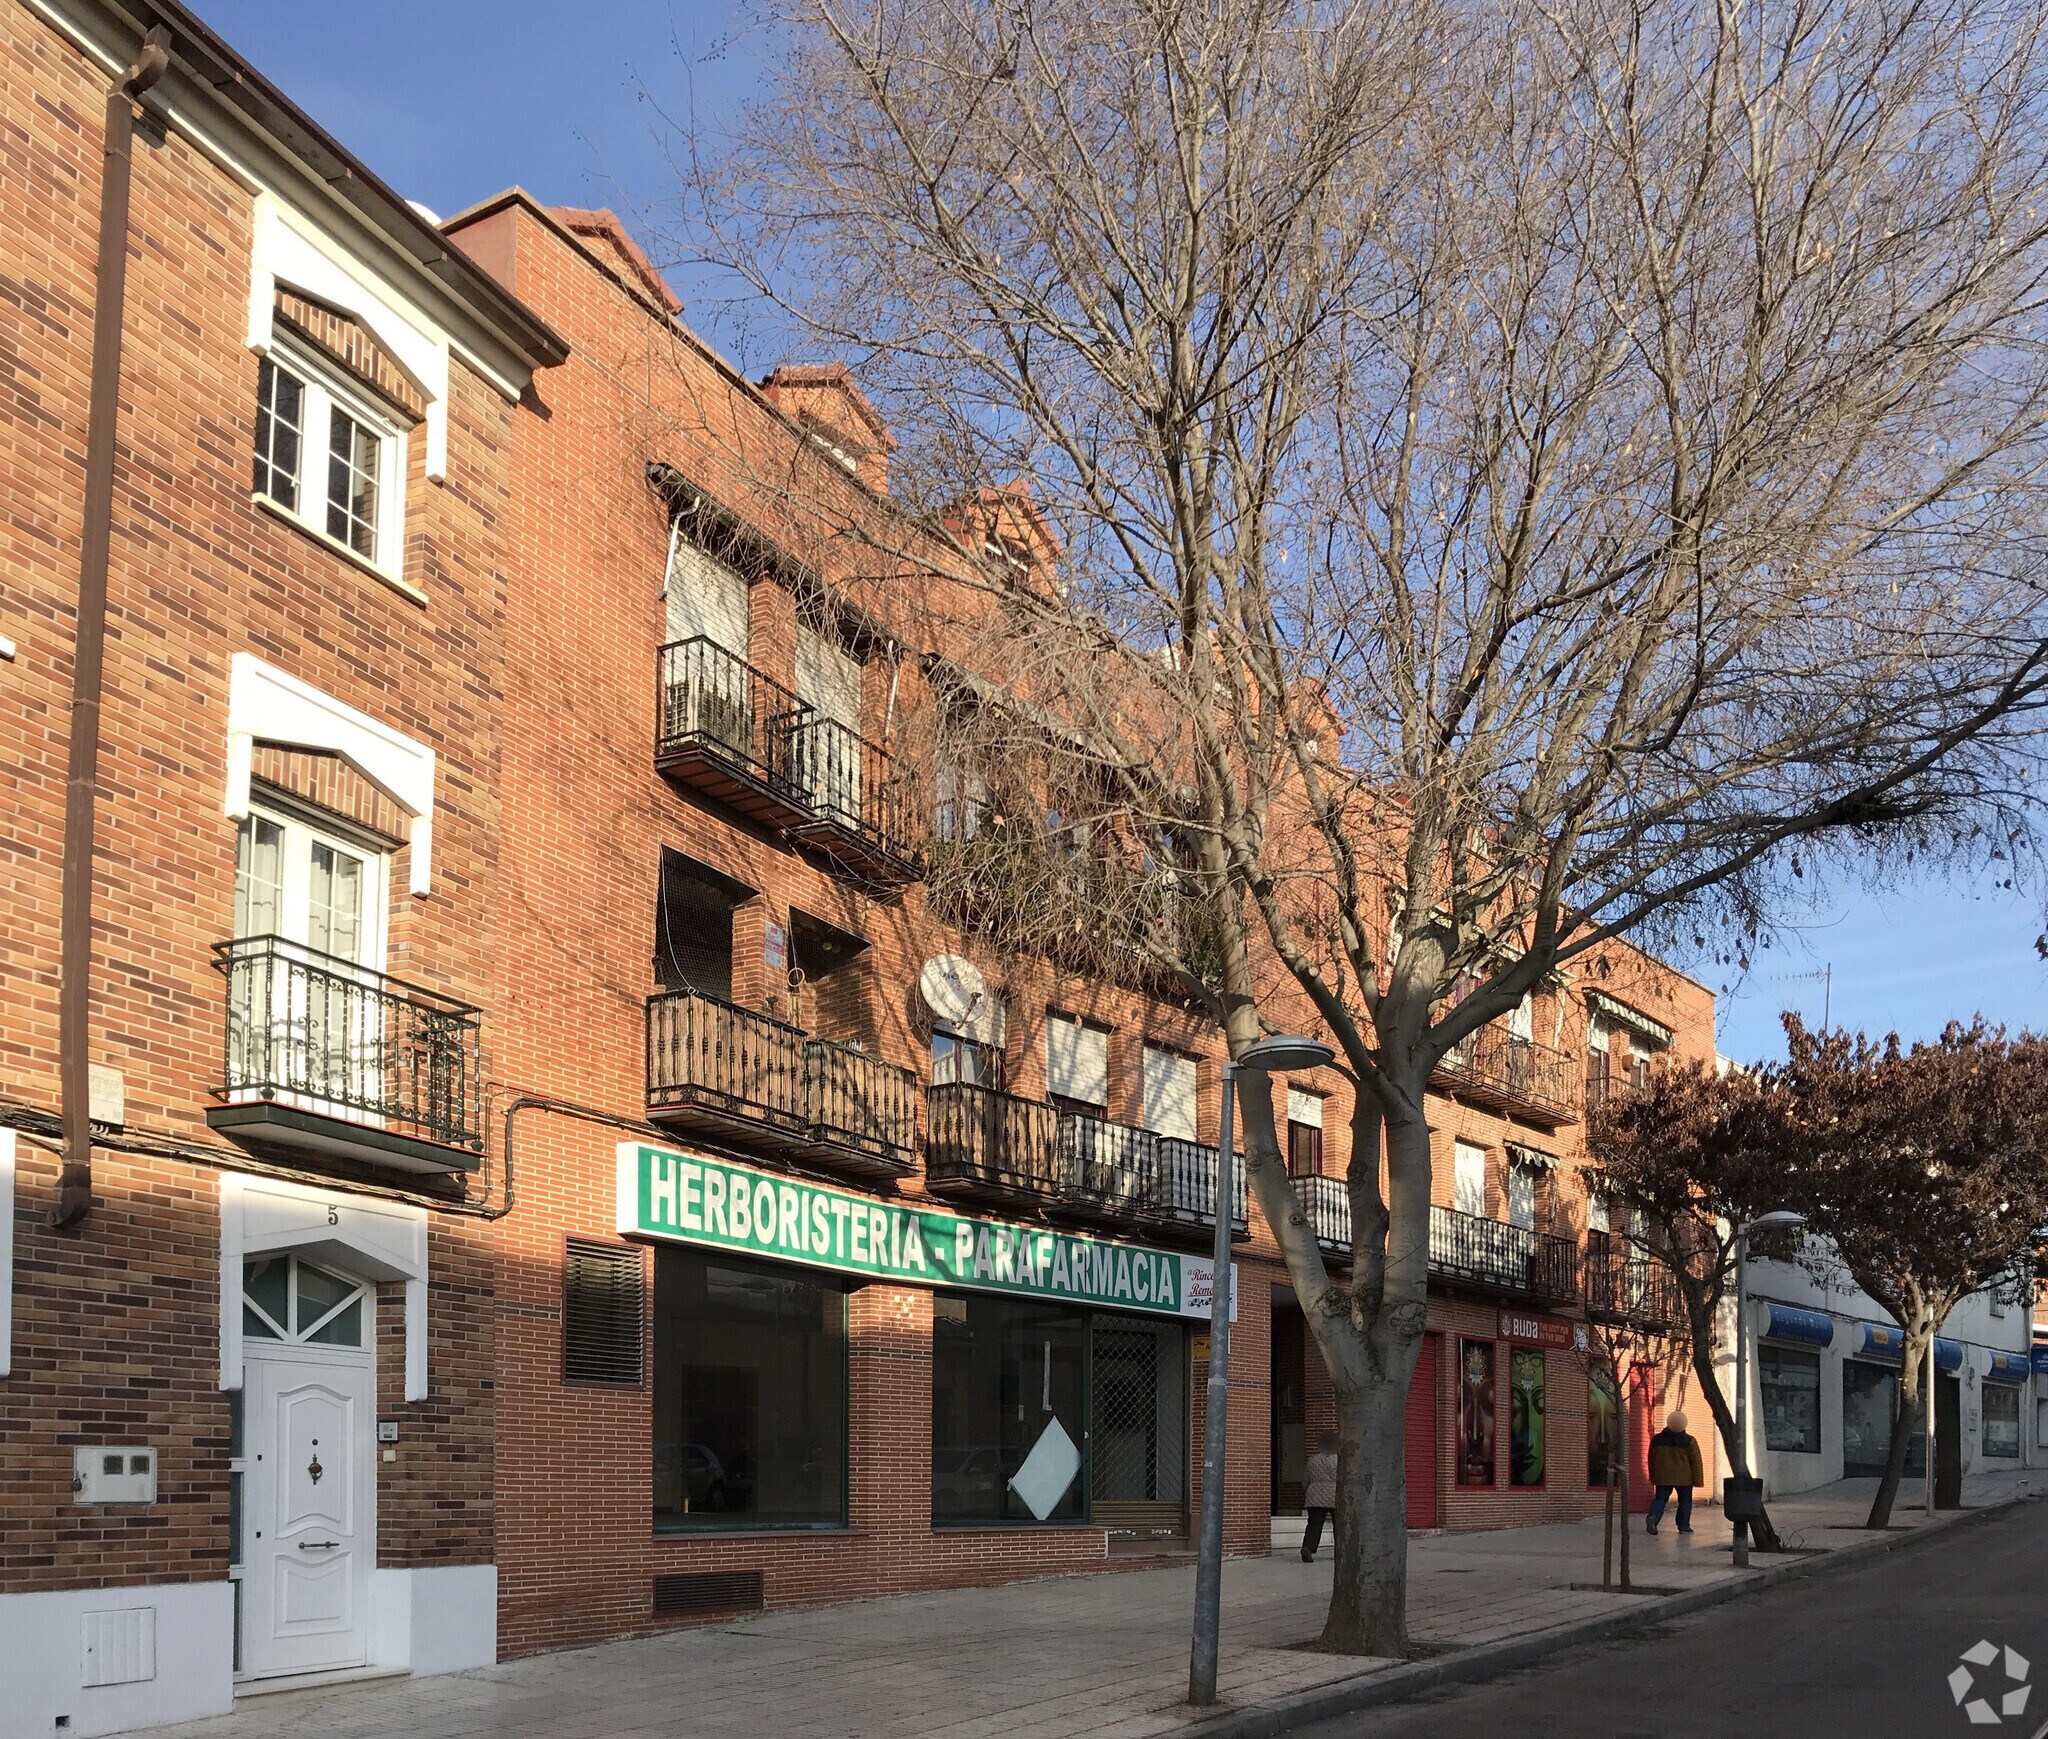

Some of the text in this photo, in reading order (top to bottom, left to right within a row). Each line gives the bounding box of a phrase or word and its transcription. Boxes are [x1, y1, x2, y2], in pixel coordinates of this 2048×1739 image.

[328, 1204, 339, 1226] 5
[650, 1154, 926, 1272] HERBORISTERIA
[955, 1222, 1175, 1305] PARAFARMACIA
